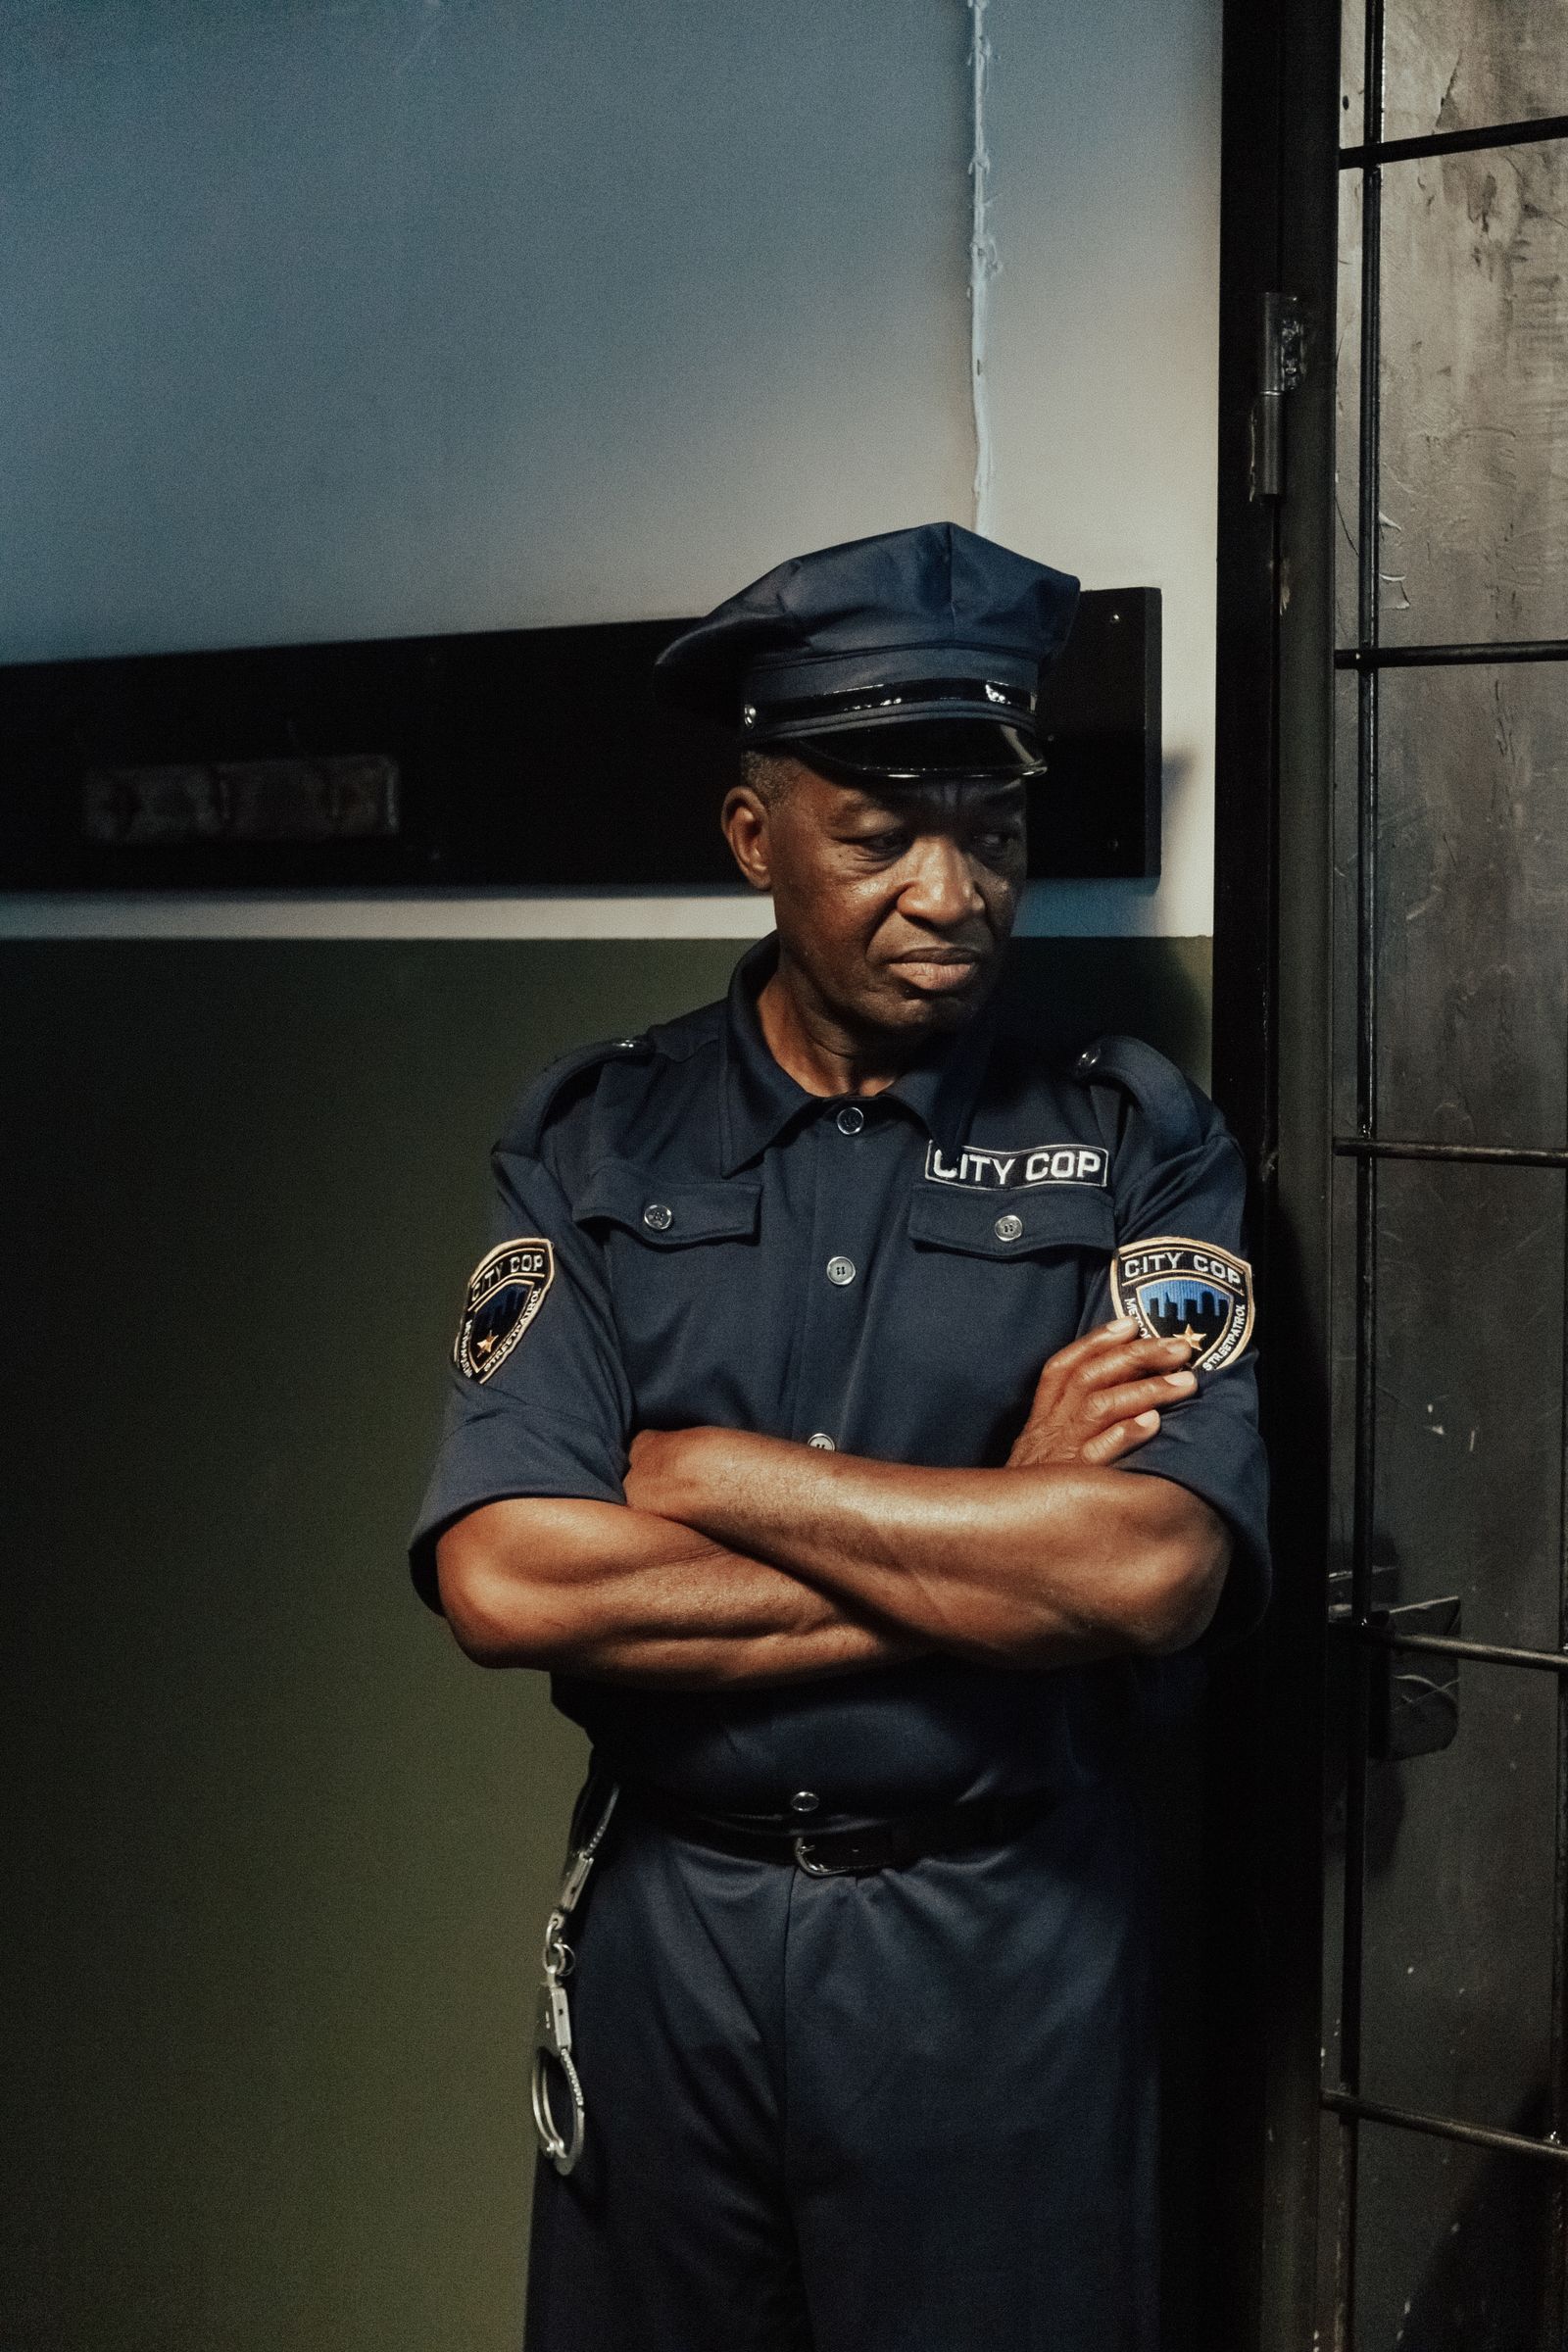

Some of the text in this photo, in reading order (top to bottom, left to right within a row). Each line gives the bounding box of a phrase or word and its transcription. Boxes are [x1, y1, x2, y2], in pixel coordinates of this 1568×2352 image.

[1025, 1151, 1102, 1182] COP
[471, 1253, 544, 1301] CITY COP
[1124, 1250, 1241, 1284] CITY COP
